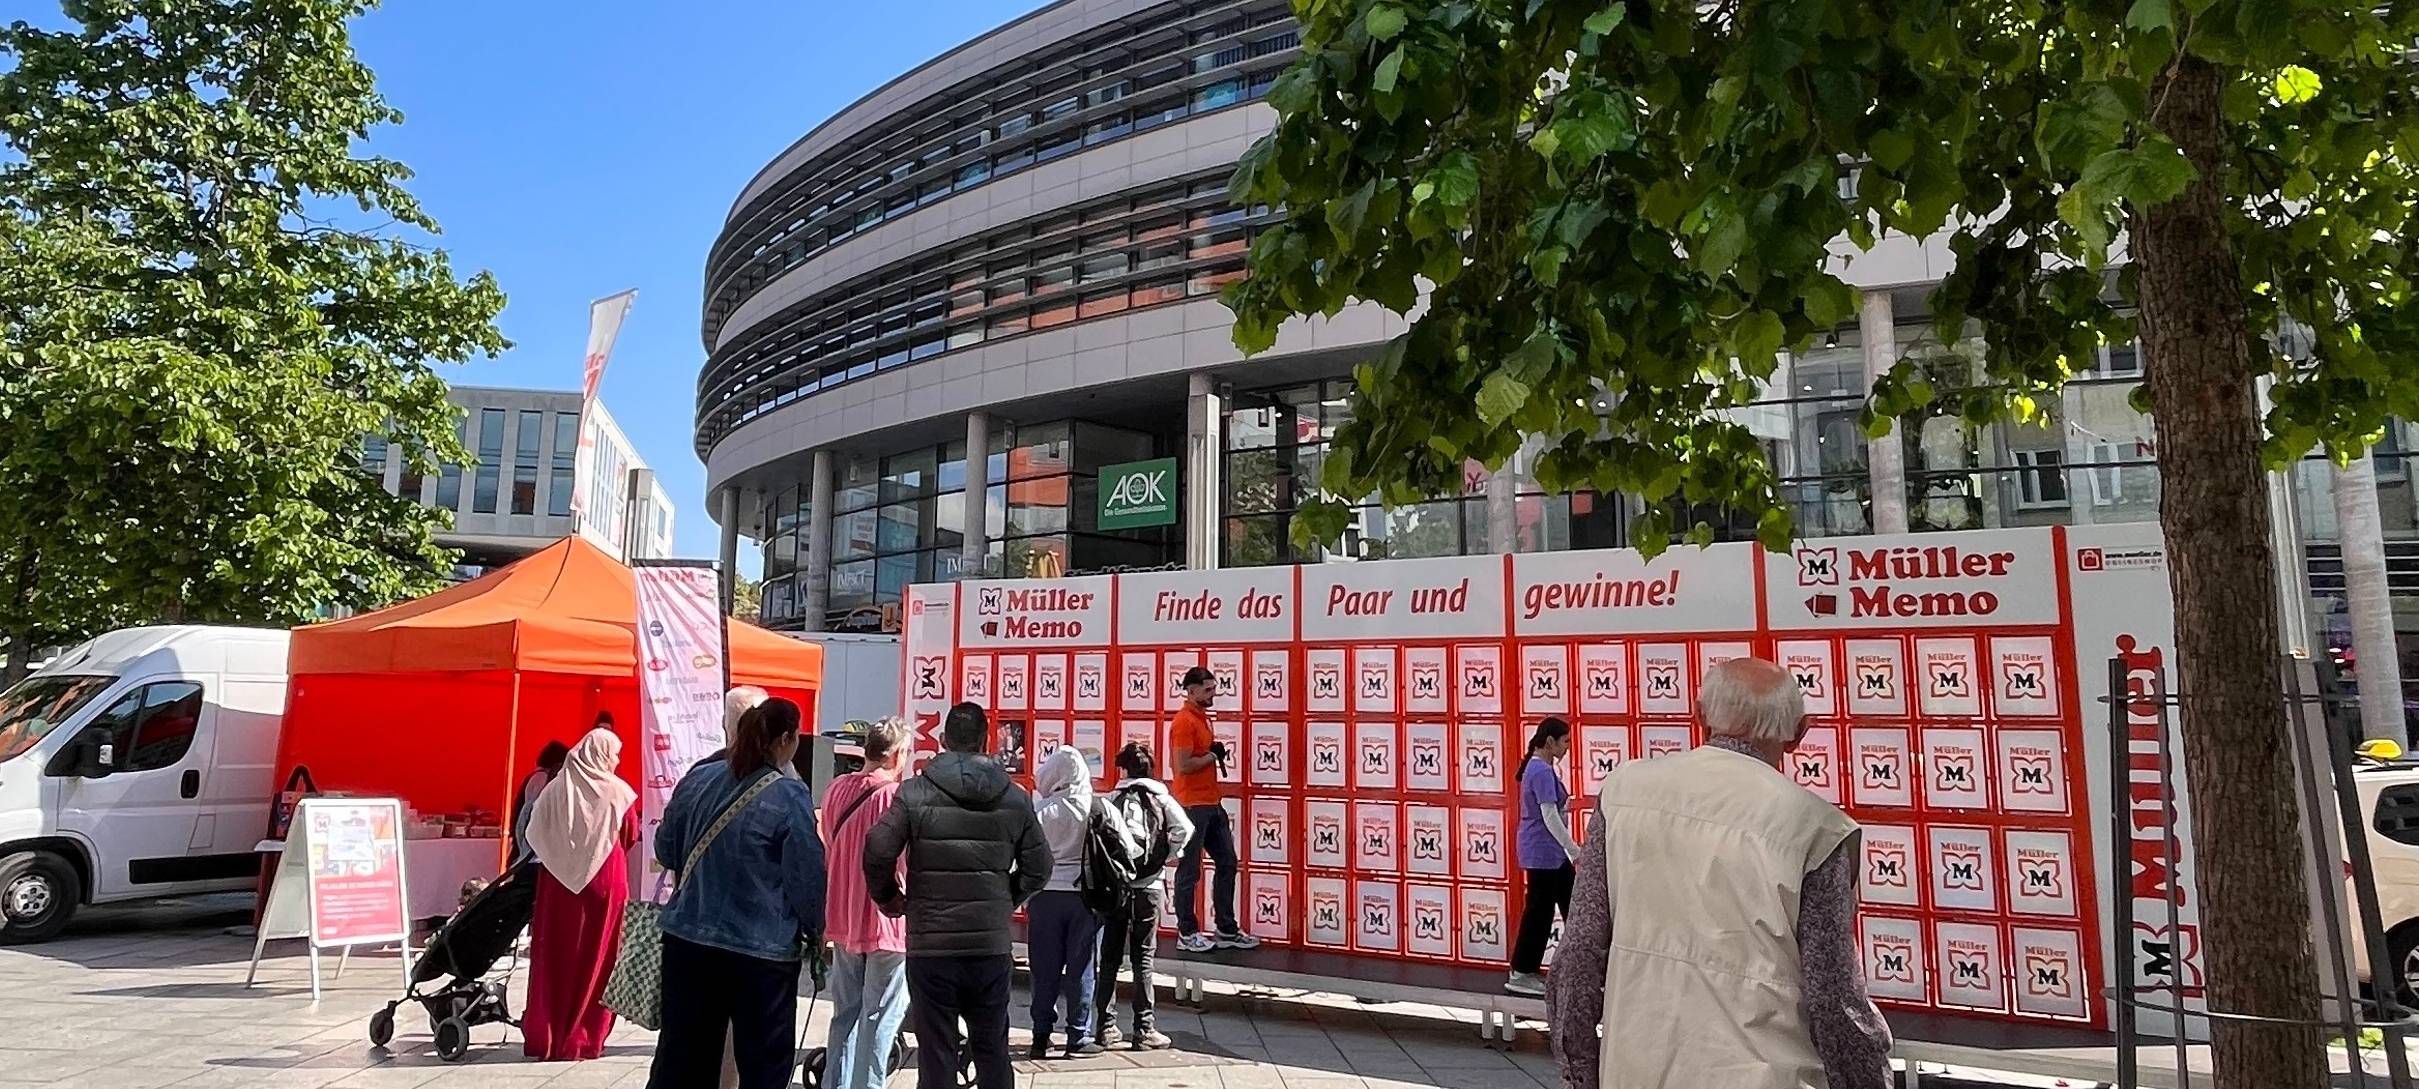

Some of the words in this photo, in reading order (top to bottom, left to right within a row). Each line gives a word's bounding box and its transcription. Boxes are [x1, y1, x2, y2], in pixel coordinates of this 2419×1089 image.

[1106, 470, 1166, 507] AOK
[1807, 558, 1829, 576] M
[1847, 546, 2015, 580] Müller
[984, 595, 996, 607] M
[1007, 589, 1094, 612] Müller
[1154, 589, 1222, 621] Finde
[1237, 587, 1283, 619] das
[1327, 584, 1393, 617] Paar
[1410, 578, 1469, 614] und
[1524, 570, 1680, 619] gewinne!
[1850, 586, 1998, 618] Memo
[1004, 616, 1083, 639] Memo
[1855, 655, 1892, 663] Müller
[1927, 653, 1967, 661] Müller
[2002, 653, 2042, 662] Müller
[922, 667, 936, 689] M
[1368, 677, 1381, 690] M
[1419, 677, 1433, 691] M
[1471, 676, 1487, 689] M
[1537, 677, 1552, 690] M
[1595, 677, 1610, 690] M
[1654, 676, 1671, 690] M
[1865, 675, 1885, 690] M
[1939, 672, 1959, 688] M
[2013, 673, 2035, 689] M
[1800, 744, 1828, 752] üller
[1861, 744, 1899, 753] Müller
[1933, 746, 1973, 755] Müller
[2009, 747, 2050, 756] Müller
[1420, 754, 1434, 767] M
[1473, 755, 1488, 769] M
[1599, 758, 1613, 772] M
[1802, 763, 1821, 777] M
[1871, 763, 1891, 780] M
[1944, 765, 1966, 781] M
[2020, 767, 2042, 783] M
[2116, 634, 2186, 907] Müller
[1320, 831, 1333, 845] M
[1421, 837, 1435, 851] M
[1867, 840, 1904, 849] Müller
[1474, 841, 1489, 854] M
[1940, 842, 1981, 852] Müller
[2017, 849, 2059, 859] Müller
[1877, 860, 1897, 876] M
[1952, 863, 1972, 879] M
[2029, 870, 2052, 887] M
[1319, 908, 1333, 921] M
[1370, 912, 1383, 926] M
[1422, 917, 1436, 931] M
[1476, 921, 1492, 935] M
[1872, 934, 1911, 944] Müller
[1948, 940, 1987, 950] Müller
[2025, 946, 2067, 957] Müller
[1883, 954, 1904, 971] M
[1959, 962, 1980, 978] M
[2037, 968, 2060, 985] M
